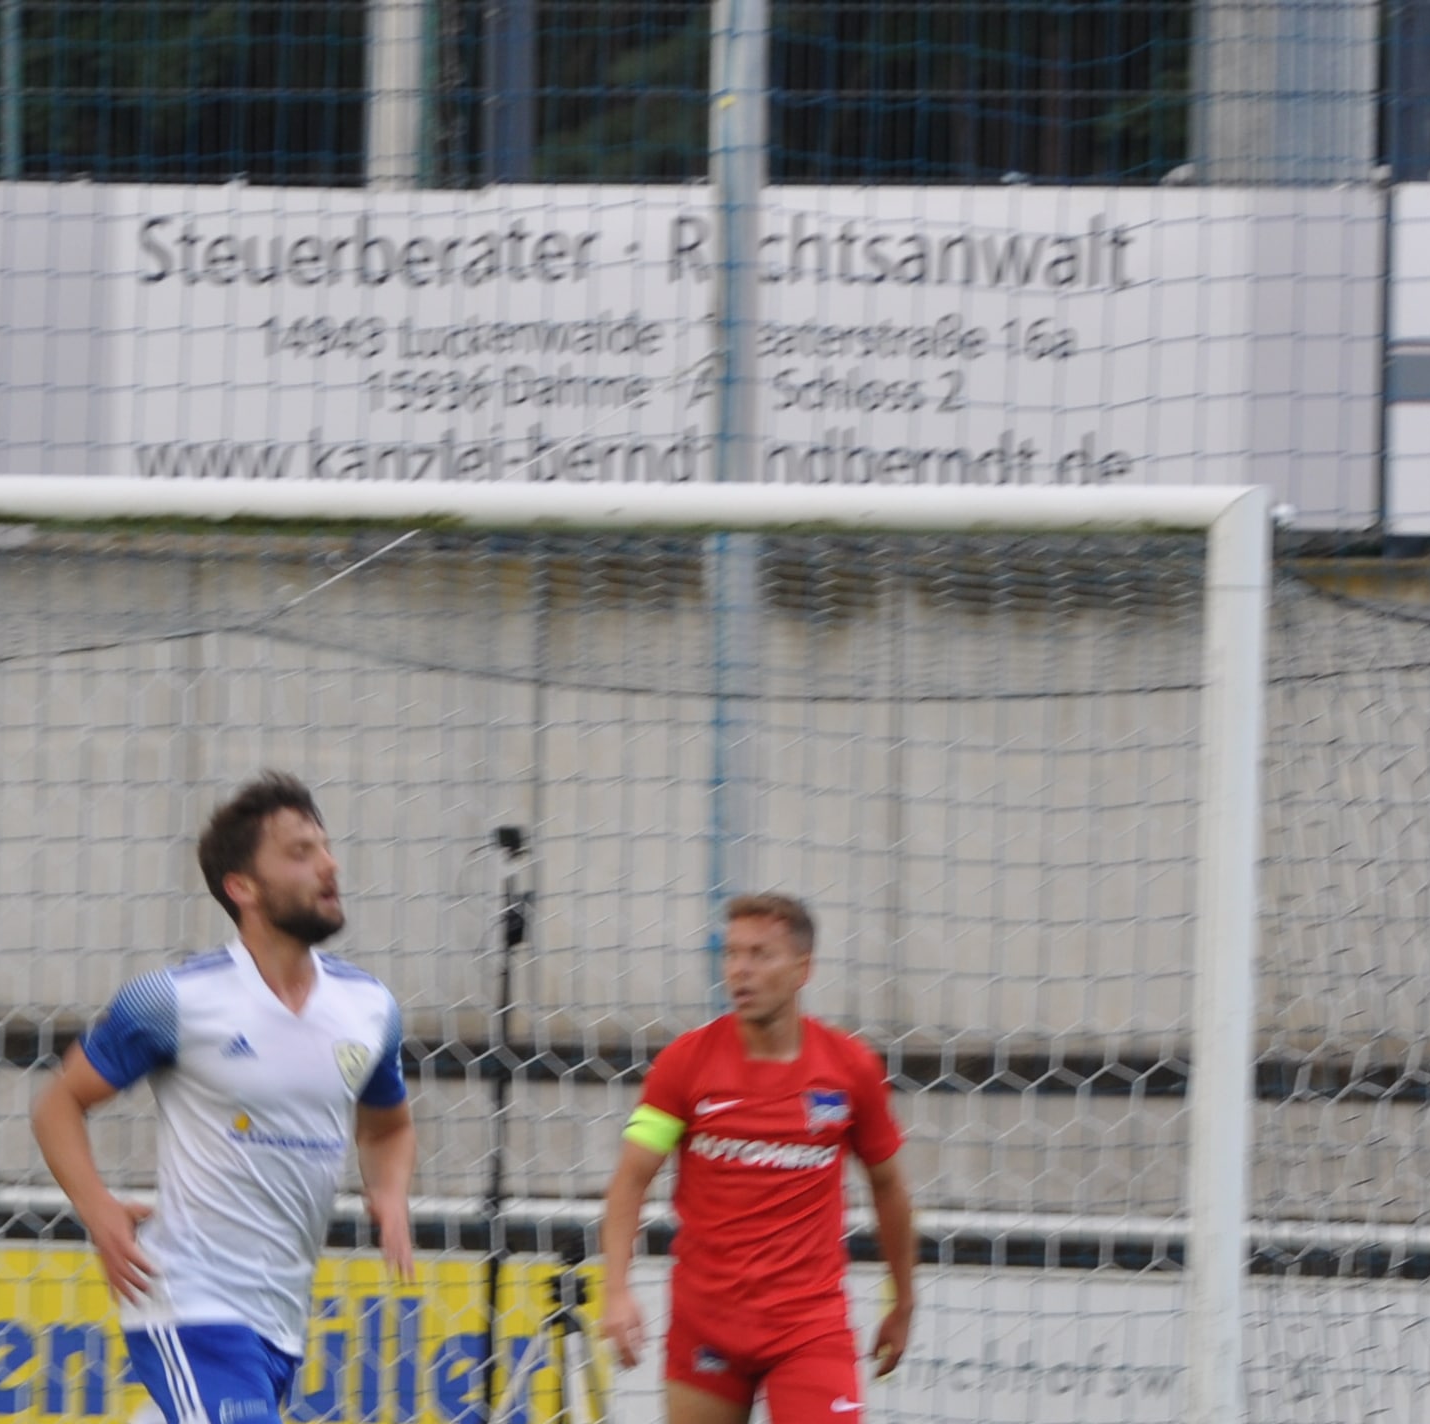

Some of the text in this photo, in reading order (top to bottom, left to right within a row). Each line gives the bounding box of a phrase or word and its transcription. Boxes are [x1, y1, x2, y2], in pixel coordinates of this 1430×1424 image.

[138, 212, 1133, 288] Steuerberater Rchtsanwalt
[1000, 317, 1079, 362] 16a
[773, 366, 925, 413] Schloss
[935, 370, 965, 414] 2
